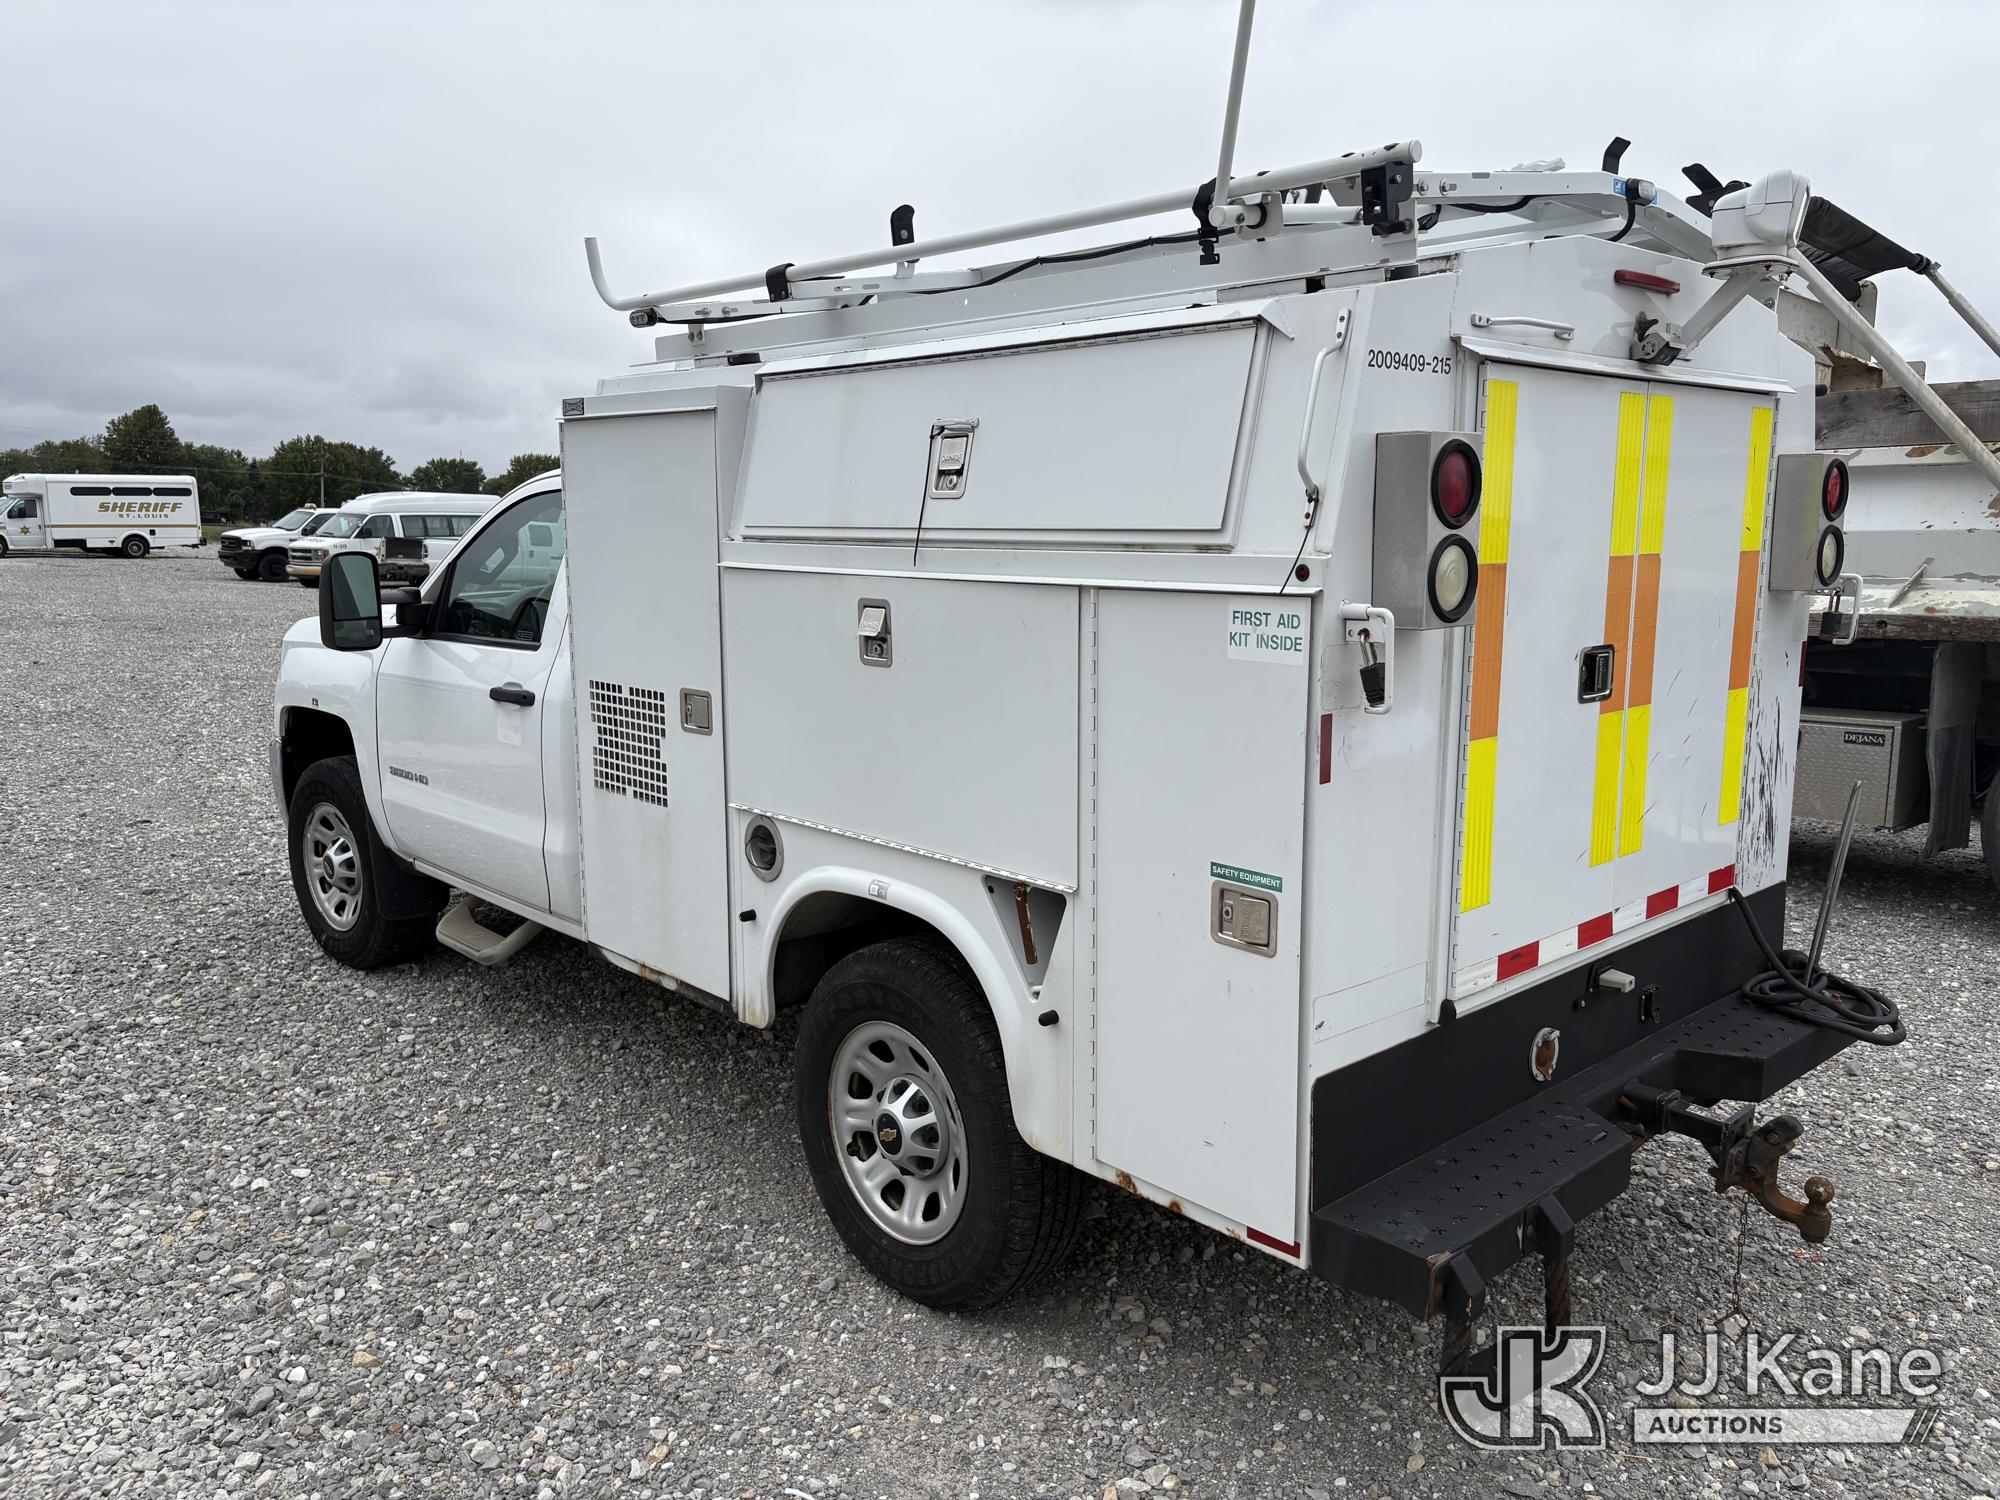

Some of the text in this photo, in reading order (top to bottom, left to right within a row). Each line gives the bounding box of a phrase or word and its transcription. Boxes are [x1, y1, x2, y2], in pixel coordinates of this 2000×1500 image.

[1367, 349, 1451, 375] 2009409-215
[98, 502, 182, 513] SHERIFF
[1232, 610, 1301, 629] FIRST AID
[1229, 631, 1303, 652] KIT INSIDE
[1845, 733, 1884, 744] DEJANA
[1212, 865, 1281, 888] SAFETY EQUIPMENT
